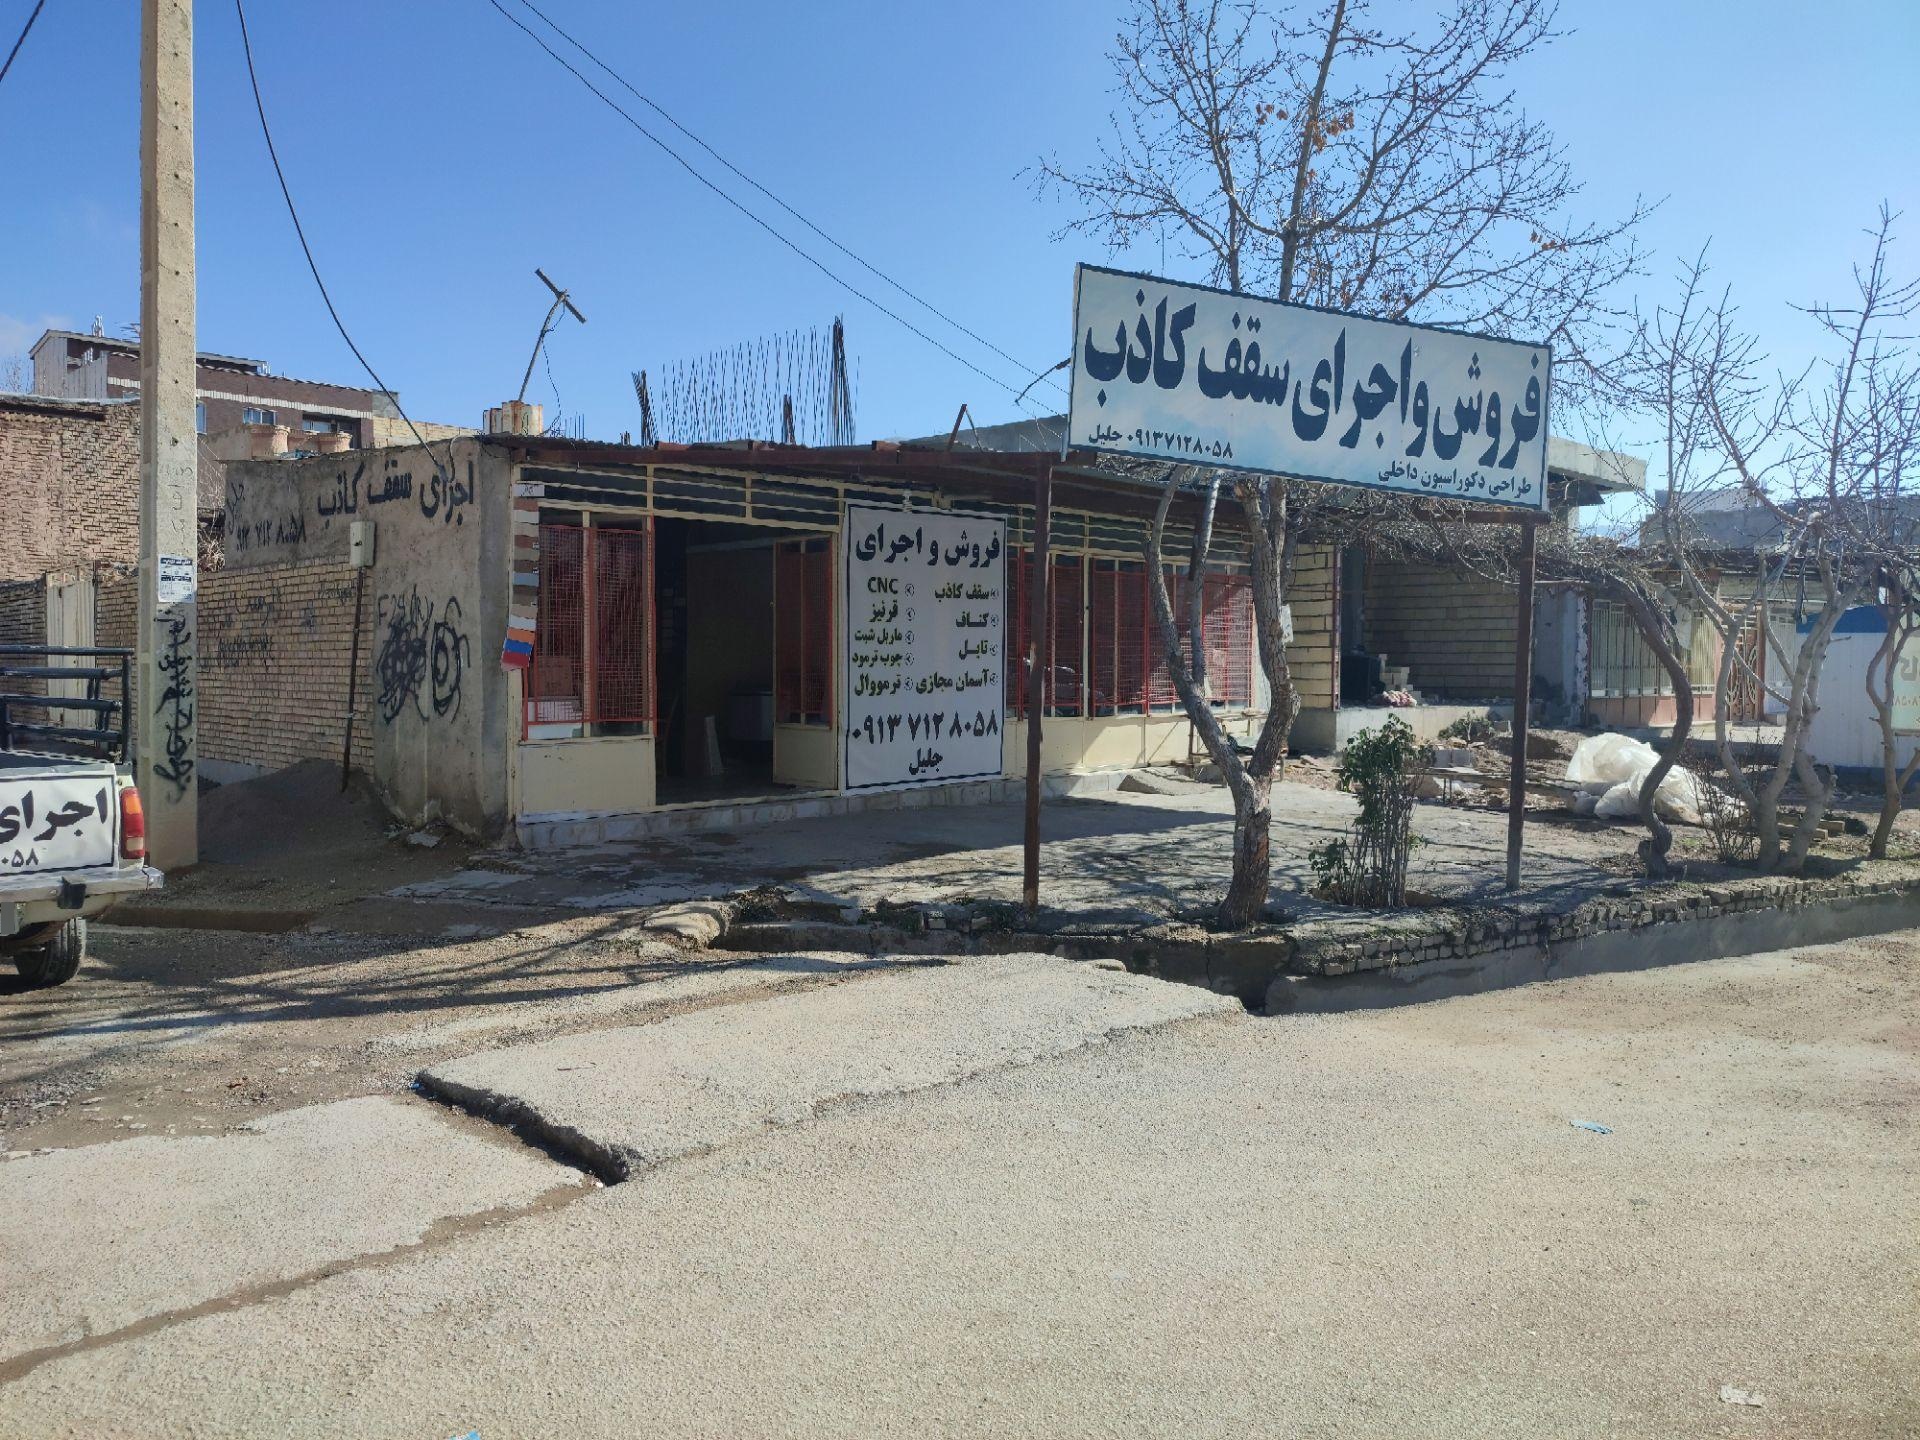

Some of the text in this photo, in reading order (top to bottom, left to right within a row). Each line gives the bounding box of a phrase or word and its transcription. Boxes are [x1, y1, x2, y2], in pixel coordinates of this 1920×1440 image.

[1083, 288, 1542, 470] فروش و اجرای سقف کاذب
[1088, 423, 1234, 459] ۰۹۱۳۷۱۲۸۰۵۸ جلیل
[316, 458, 475, 531] اجرای سقف کاذب
[1377, 459, 1533, 500] طراحی دکوراسیون داخلی
[855, 521, 1001, 569] فروش و اجرای
[866, 575, 899, 595] CNC
[934, 581, 990, 604] سقف کاذب
[867, 598, 899, 623] قرنیز
[954, 609, 990, 629] کناف
[876, 626, 903, 646] ماربل
[958, 637, 989, 661] تایل
[914, 666, 991, 696] آسمان مجازی
[851, 713, 903, 745] ۰۹۱۳
[907, 746, 944, 776] جلیل
[0, 786, 108, 846] اجرای
